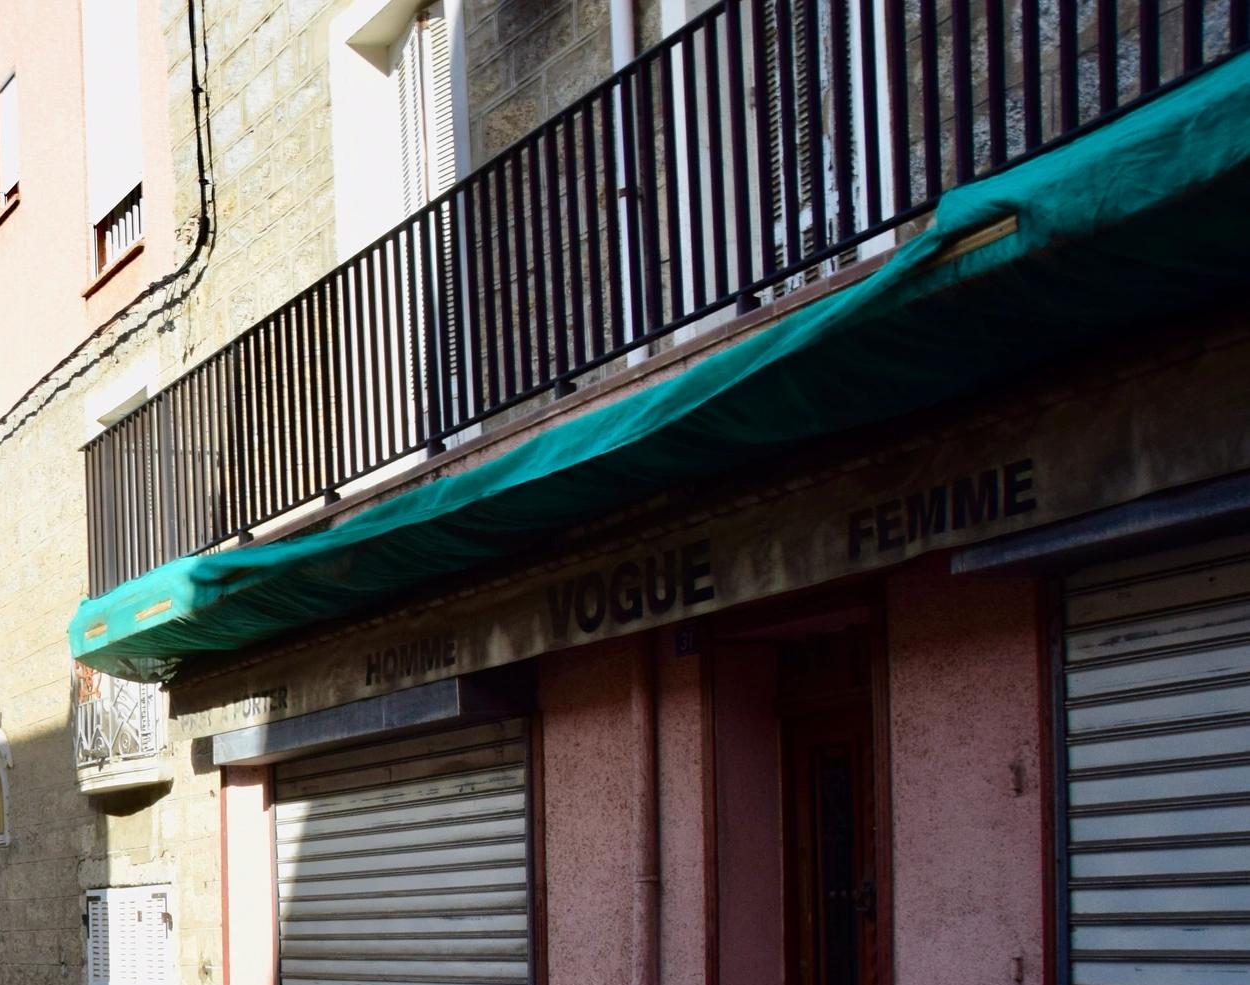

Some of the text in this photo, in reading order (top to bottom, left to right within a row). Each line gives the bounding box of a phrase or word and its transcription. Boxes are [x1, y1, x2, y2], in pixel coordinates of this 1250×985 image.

[365, 634, 456, 686] HOMME
[547, 540, 715, 639] VOGUE
[848, 459, 1036, 560] FEMME
[679, 631, 694, 652] 31
